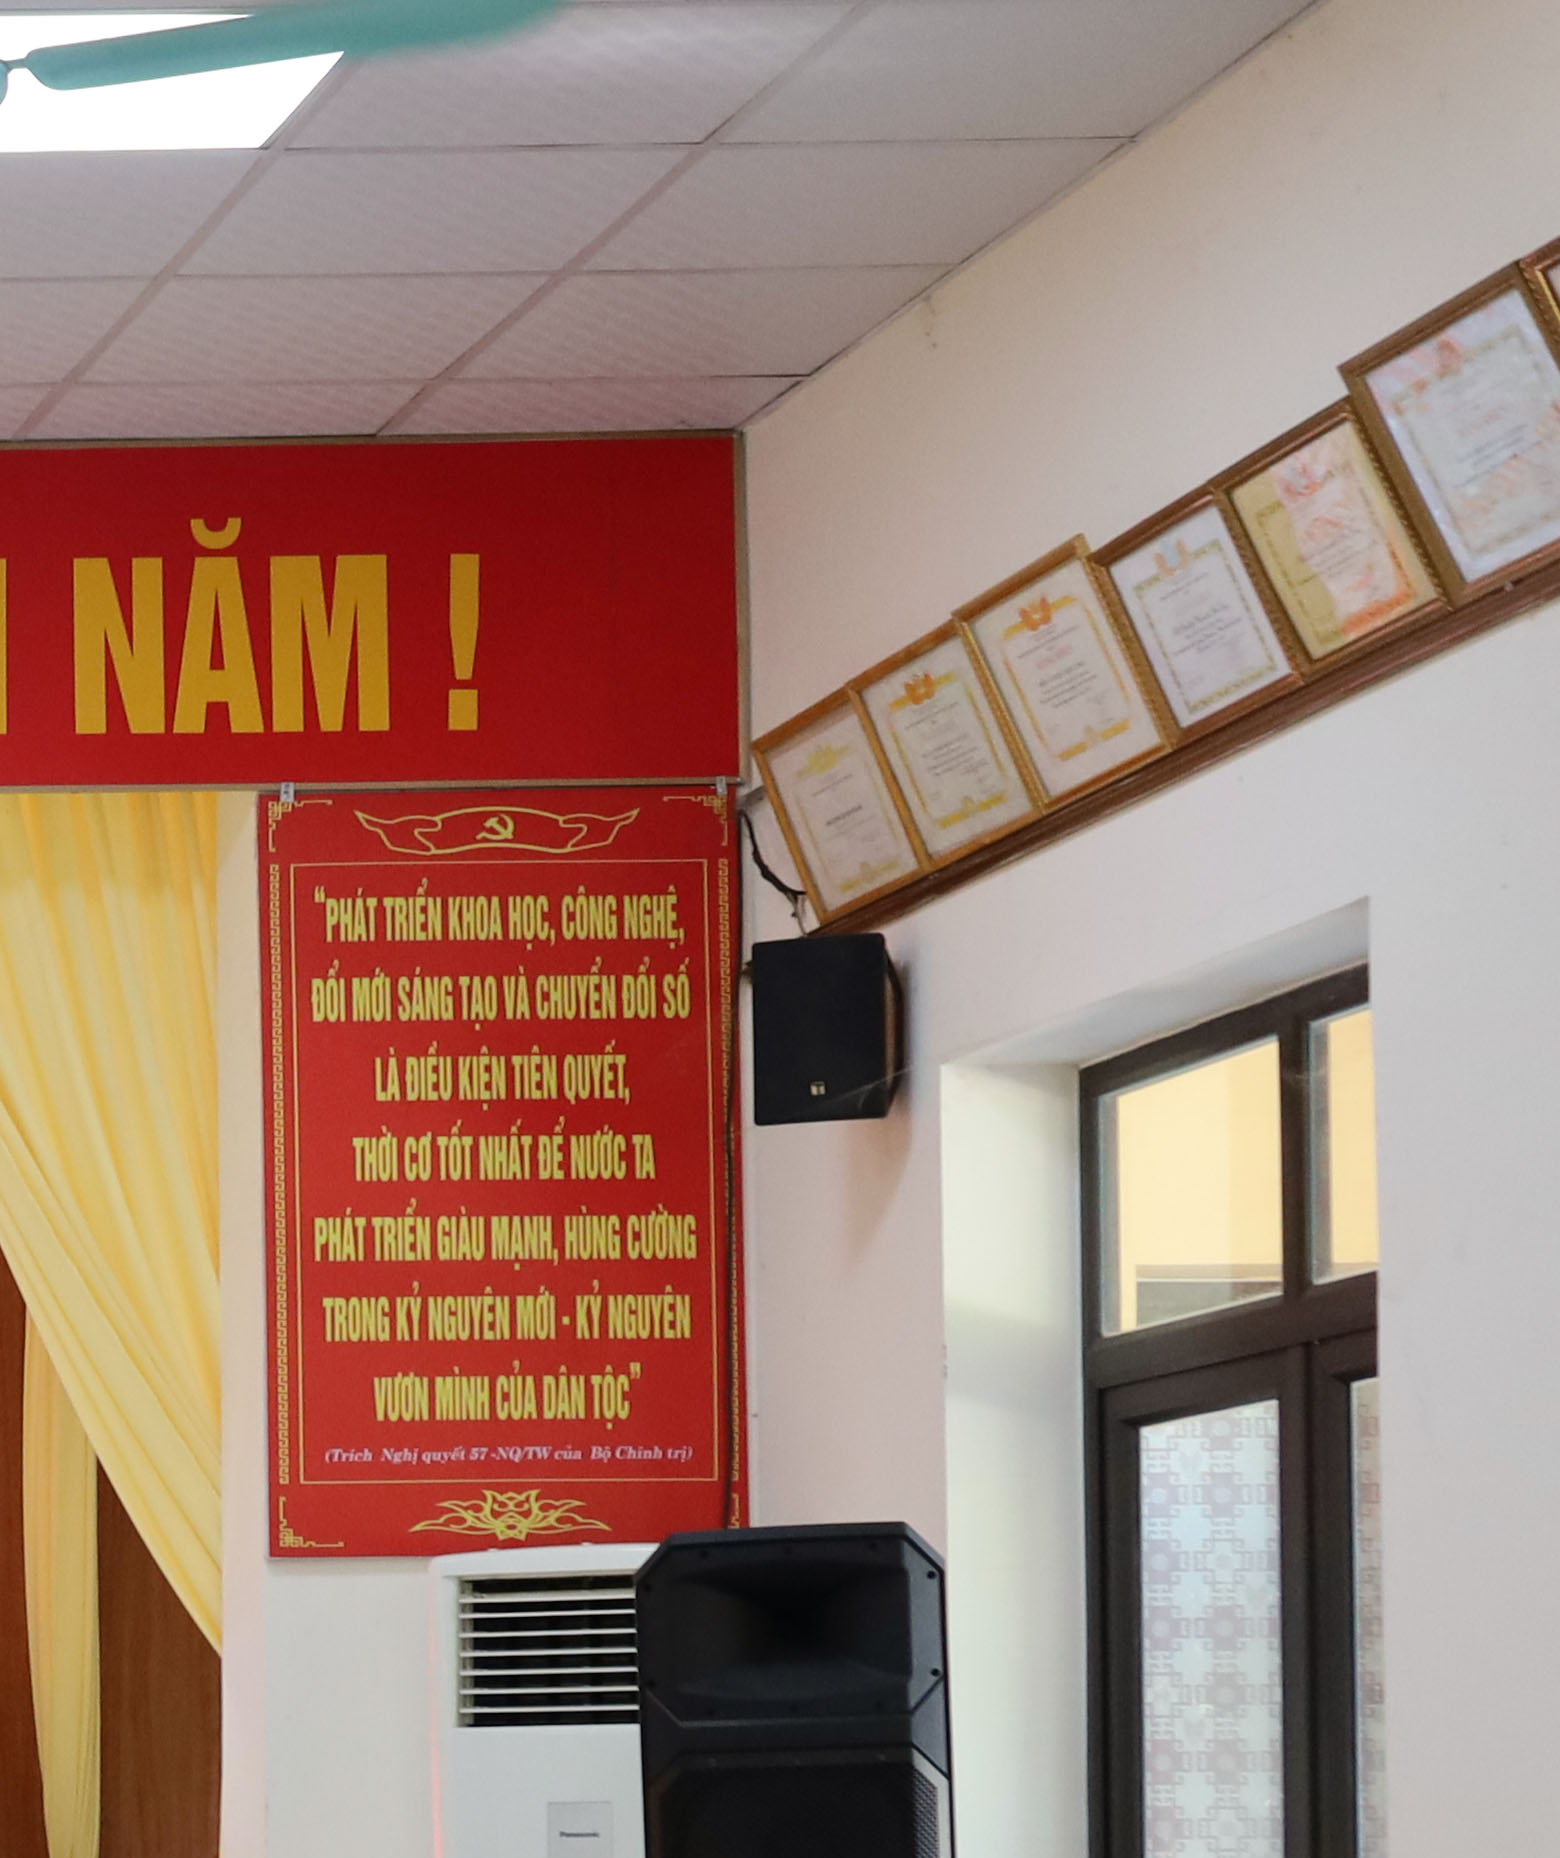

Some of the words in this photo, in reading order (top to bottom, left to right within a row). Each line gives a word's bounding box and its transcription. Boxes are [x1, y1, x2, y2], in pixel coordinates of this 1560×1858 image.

[74, 518, 390, 734] NĂM
[449, 554, 479, 731] !
[382, 879, 444, 941] TRIỂN
[447, 895, 505, 941] KHOA
[508, 895, 557, 949] HỌC,
[561, 885, 619, 940] CÔNG
[623, 886, 686, 948] NGHỆ,
[311, 957, 347, 1022] ĐỔI
[351, 962, 393, 1022] MỚI
[397, 964, 455, 1022] SÁNG
[458, 975, 499, 1030] TẠO
[503, 964, 532, 1020] VÀ
[535, 956, 618, 1020] CHUYỂN
[621, 957, 658, 1019] ĐỔI
[662, 957, 692, 1019] SỐ
[375, 1047, 402, 1102] LÀ
[405, 1043, 454, 1101] ĐIỀU
[458, 1046, 508, 1110] KIỆN
[511, 1045, 559, 1100] TIÊN
[563, 1039, 631, 1103] QUYẾT,
[351, 1122, 401, 1182] THỜI
[403, 1132, 433, 1181] CƠ
[436, 1119, 475, 1181] TỐT
[478, 1118, 534, 1180] NHẤT
[537, 1116, 566, 1180] ĐỂ
[570, 1124, 628, 1180] NƯỚC
[631, 1133, 657, 1179] TA
[313, 1207, 369, 1262] PHÁT
[371, 1199, 433, 1262] TRIỂN
[436, 1207, 487, 1261] GIÀU
[490, 1215, 561, 1270] MẠNH,
[564, 1206, 623, 1260] HÙNG
[626, 1203, 699, 1260] CƯỜNG
[321, 1295, 393, 1342] TRONG
[395, 1282, 425, 1341] KỶ
[426, 1286, 512, 1341] NGUYÊN
[515, 1286, 557, 1341] MỚI
[575, 1279, 603, 1339] KỶ
[607, 1285, 693, 1340] NGUYÊN
[373, 1372, 431, 1422] VƯƠN
[434, 1366, 492, 1421] MÌNH
[495, 1360, 539, 1420] CỦA
[543, 1365, 587, 1420] DÂN
[381, 1449, 418, 1465] Nghị
[421, 1446, 466, 1464] quyết
[469, 1447, 488, 1461] 57
[554, 1445, 582, 1461] của
[590, 1446, 611, 1463] Bộ
[615, 1445, 662, 1460] Chính
